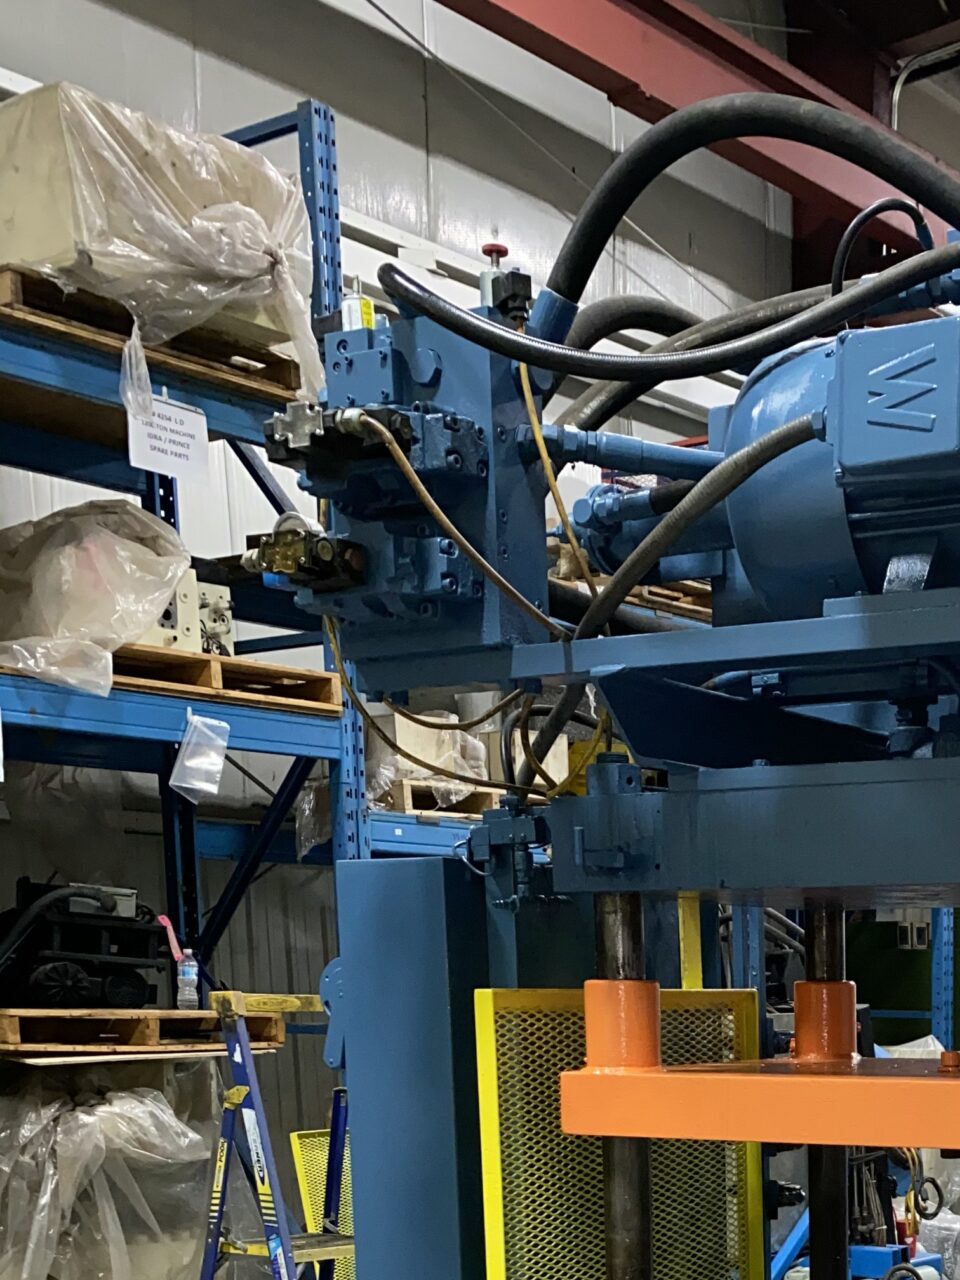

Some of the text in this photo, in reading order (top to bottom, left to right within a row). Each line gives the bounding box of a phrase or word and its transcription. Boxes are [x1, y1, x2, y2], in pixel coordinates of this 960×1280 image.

[169, 427, 196, 440] MACHINE
[168, 438, 190, 450] PRINCE
[149, 444, 189, 461] SPARE PARTS
